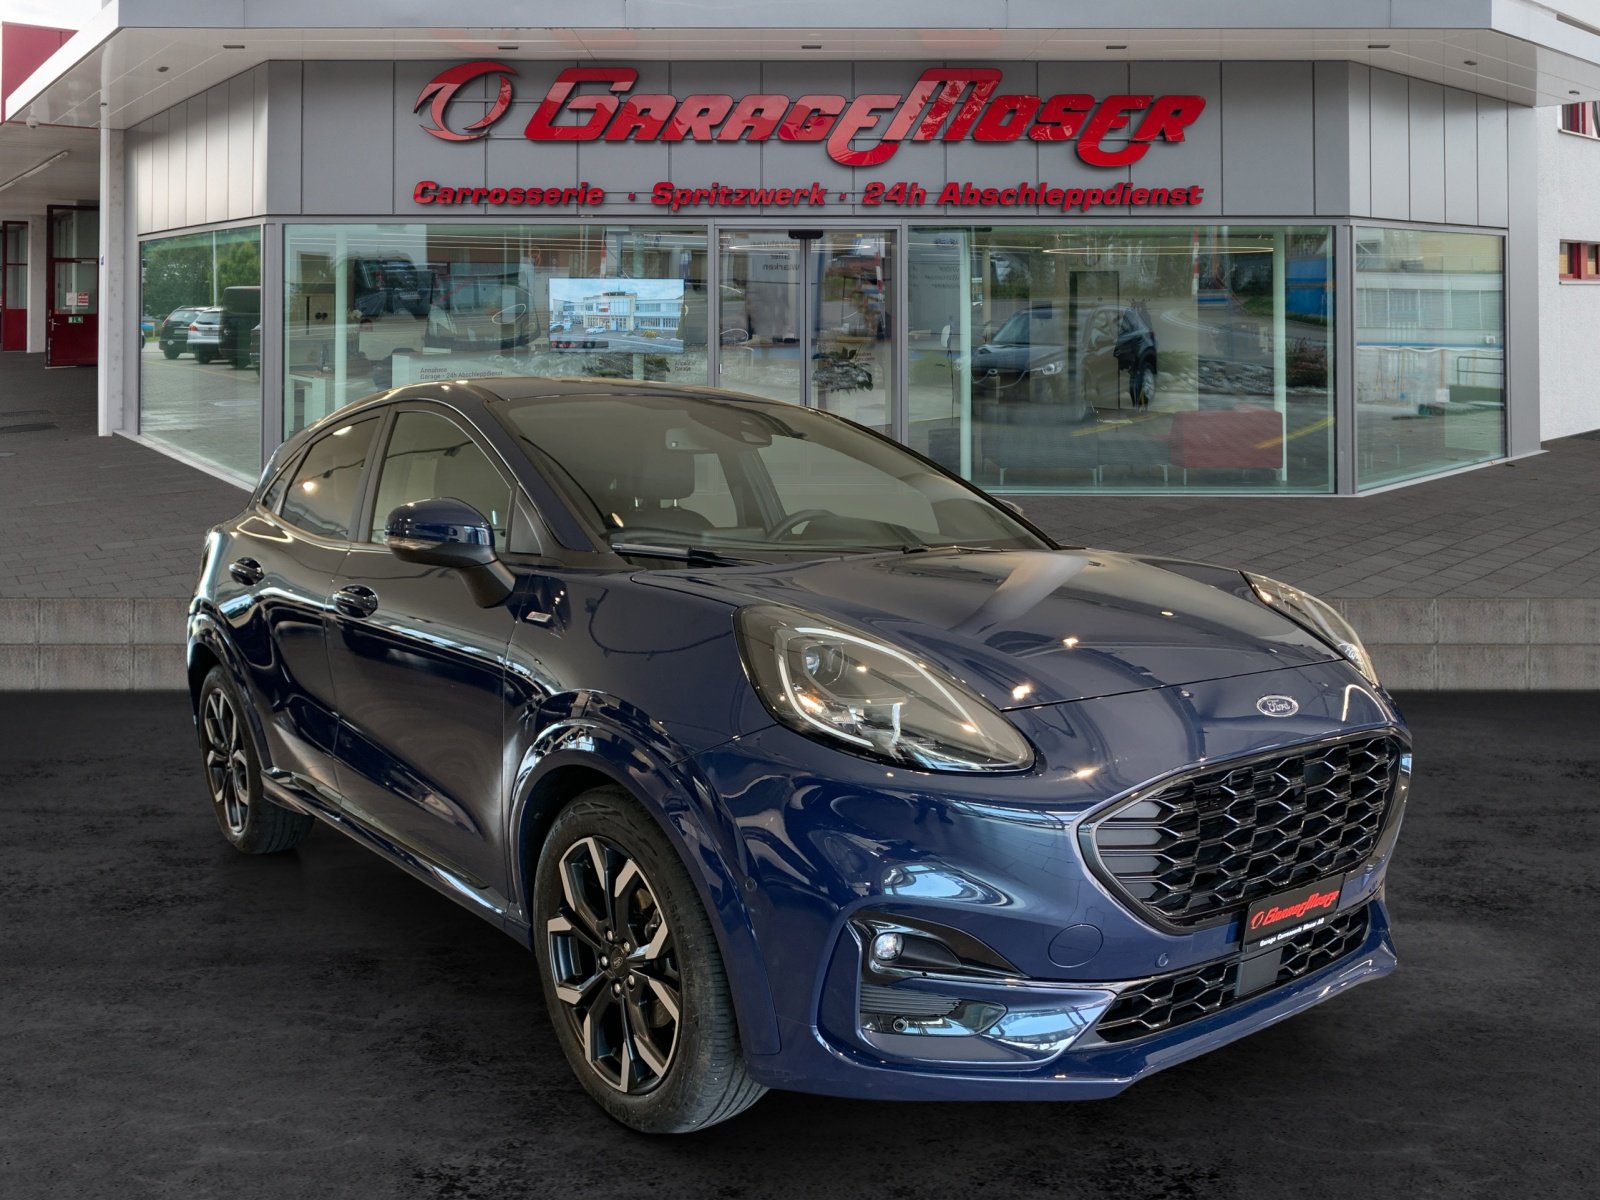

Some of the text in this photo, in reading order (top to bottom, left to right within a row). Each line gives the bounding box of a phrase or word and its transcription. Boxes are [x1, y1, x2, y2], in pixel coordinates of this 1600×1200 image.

[413, 181, 1205, 211] Carrosserie Spritzwerk 24h Abschleppdienst
